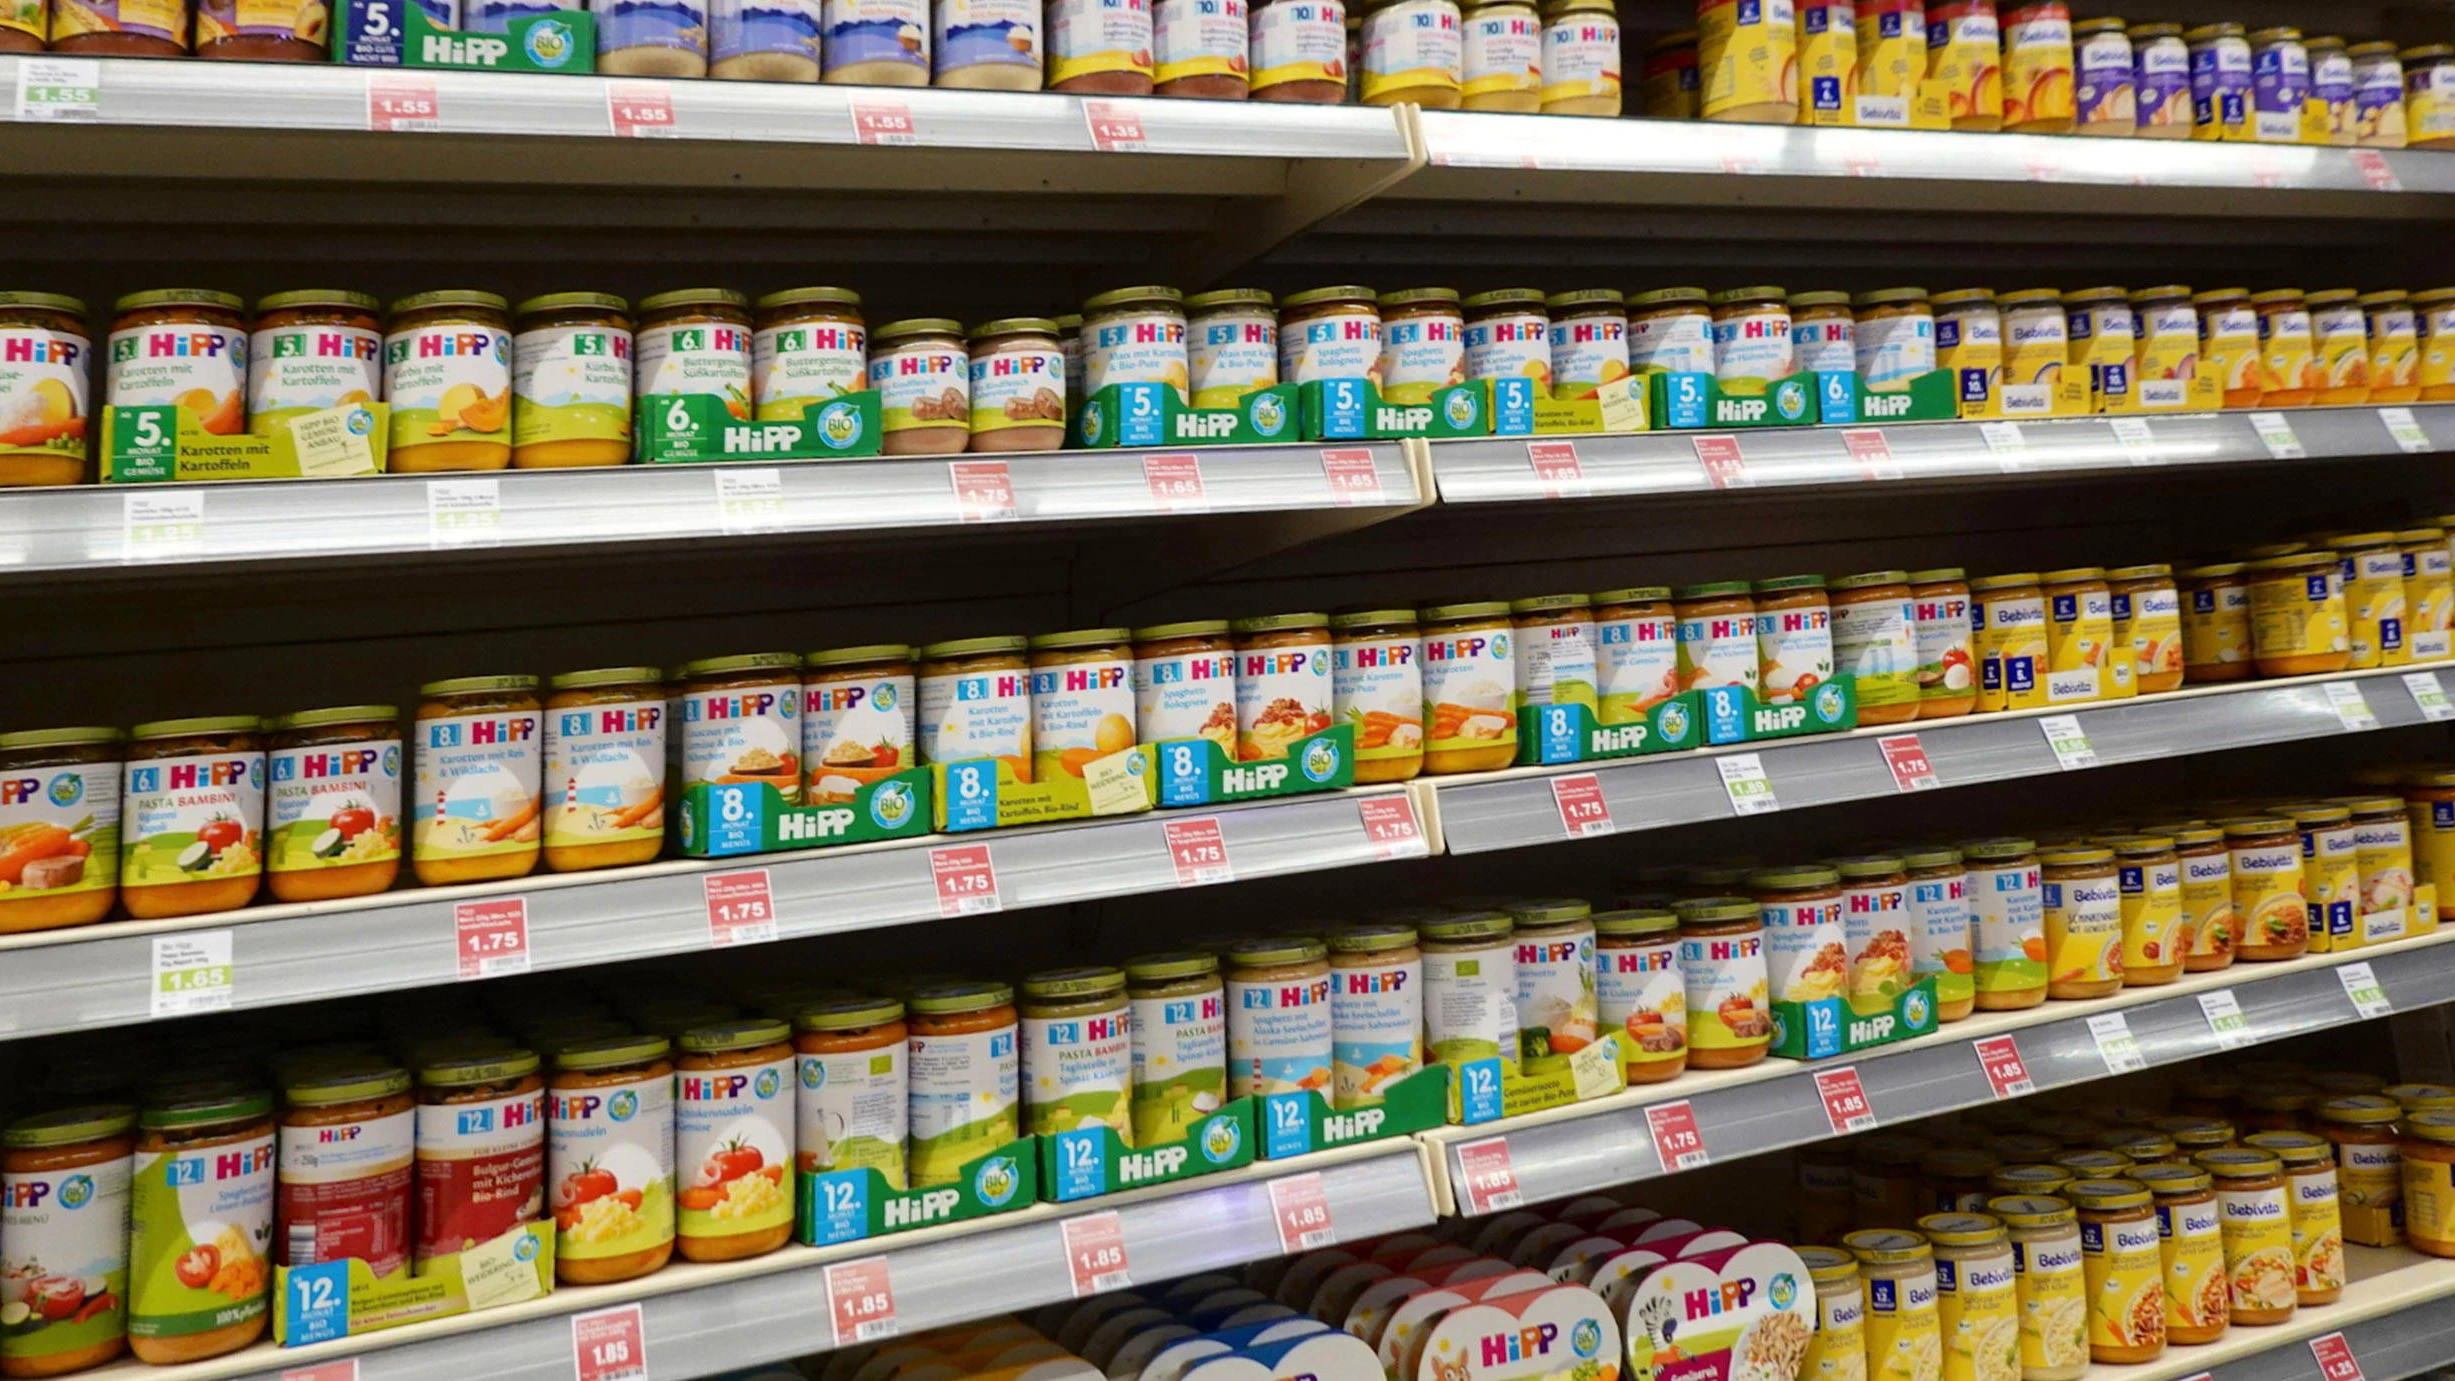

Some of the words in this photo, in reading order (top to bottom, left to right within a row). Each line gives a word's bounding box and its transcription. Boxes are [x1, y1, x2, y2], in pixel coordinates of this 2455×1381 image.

[364, 3, 400, 36] 5.
[422, 35, 509, 65] HiPP
[535, 36, 562, 51] BIO
[34, 89, 91, 102] 1.55
[380, 101, 430, 114] 1.55
[622, 107, 668, 121] 1.55
[865, 115, 907, 130] 1.55
[1099, 124, 1138, 138] 1.35
[816, 327, 865, 352] HiPP
[1136, 323, 1185, 344] HiPP
[1496, 322, 1545, 342] HiPP
[1574, 319, 1622, 343] HiPP
[1746, 321, 1789, 340] HiPP
[5, 338, 78, 366] HiPP
[149, 333, 226, 358] HiPP
[318, 333, 379, 361] HiPP
[419, 334, 490, 359] HiPP
[901, 356, 953, 375] HiPP
[994, 356, 1045, 376] HiPP
[1336, 381, 1362, 410] 5.
[1506, 382, 1530, 409] 5.
[1679, 377, 1703, 402] 5.
[1828, 374, 1850, 401] 6.
[1133, 387, 1160, 416] 5.
[1716, 399, 1768, 422] HiPP
[1864, 395, 1913, 417] HiPP
[666, 399, 700, 431] 6.
[828, 417, 852, 431] BIO
[1176, 412, 1240, 438] HiPP
[1376, 406, 1434, 432] HiPP
[134, 411, 173, 448] 5.
[724, 425, 803, 453] HiPP
[126, 447, 163, 458] MONAT
[180, 446, 244, 460] Karotten
[247, 444, 271, 457] mit
[663, 449, 699, 459] GEMÜSE
[673, 440, 690, 450] BIO
[124, 465, 167, 478] GEMÜSE
[135, 456, 157, 468] BIO
[180, 459, 252, 474] Kartoffeln
[1784, 610, 1828, 632] HiPP
[1917, 600, 1965, 621] HiPP
[1551, 626, 1579, 639] HiPP
[1358, 645, 1412, 667] HiPP
[1428, 638, 1486, 661] HiPP
[1161, 664, 1178, 682] 8.
[1247, 652, 1307, 677] HiPP
[1435, 664, 1474, 675] Karotten
[966, 680, 986, 699] 8.
[1066, 667, 1125, 692] HiPP
[2053, 682, 2092, 696] Bebivita
[806, 686, 866, 712] HiPP
[1163, 687, 1207, 701] Spaghetti
[1163, 697, 1209, 711] Bolognese
[1715, 690, 1738, 717] 8.
[708, 692, 775, 720] HiPP
[968, 703, 1009, 717] Karotten
[569, 714, 587, 735] 8.
[602, 707, 661, 734] HiPP
[1550, 709, 1574, 738] 8.
[1754, 705, 1807, 732] HiPP
[439, 725, 456, 747] 8.
[471, 718, 536, 746] HiPP
[1592, 725, 1648, 753] HiPP
[570, 741, 615, 754] Karotten
[617, 739, 634, 749] mit
[303, 749, 378, 779] HiPP
[440, 752, 484, 767] Karotten
[486, 751, 506, 762] mit
[581, 752, 630, 765] Wildlachs
[1173, 746, 1202, 776] 8.
[1310, 752, 1332, 766] BIO
[1896, 760, 1928, 776] 1.75
[170, 760, 246, 790] HiPP
[450, 763, 501, 778] Wildlachs
[1223, 763, 1289, 795] HiPP
[277, 785, 308, 798] PASTA
[310, 780, 367, 796] BAMBINI
[960, 767, 991, 798] 8.
[1180, 785, 1193, 794] BIO
[138, 796, 174, 809] PASTA
[177, 792, 237, 808] BAMBINI
[721, 786, 755, 822] 8.
[880, 797, 905, 811] BIO
[999, 797, 1039, 808] Karotten
[1039, 794, 1053, 804] mit
[999, 806, 1043, 819] Kartoffeln,
[1044, 802, 1080, 814] Bio-Rind
[1568, 801, 1603, 818] 1.75
[966, 807, 981, 817] BIO
[728, 831, 744, 840] BIO
[778, 809, 857, 840] HiPP
[1376, 823, 1413, 839] 1.75
[1181, 847, 1221, 864] 1.75
[2241, 854, 2294, 870] Bebivita
[945, 874, 989, 893] 1.75
[718, 902, 766, 921] 1.75
[1851, 891, 1902, 913] HiPP
[1797, 903, 1842, 927] HiPP
[468, 932, 519, 953] 1.75
[1518, 941, 1576, 964] HiPP
[1710, 937, 1760, 960] HiPP
[1618, 950, 1673, 973] HiPP
[169, 966, 224, 990] 1.65
[1349, 970, 1408, 994] HiPP
[1280, 980, 1328, 1009] HiPP
[1294, 1012, 1308, 1021] mit
[1812, 1006, 1836, 1032] 12.
[1176, 1027, 1206, 1039] PASTA
[1850, 1015, 1895, 1045] HiPP
[1058, 1049, 1092, 1061] PASTA
[1469, 1067, 1498, 1095] 12.
[1992, 1062, 2022, 1079] 1.85
[684, 1074, 748, 1101] HiPP
[550, 1096, 601, 1121] HiPP
[1274, 1098, 1305, 1128] 12.
[1832, 1097, 1864, 1114] 1.85
[319, 1126, 362, 1143] HiPP
[1323, 1108, 1386, 1143] HiPP
[1210, 1133, 1232, 1148] BIO
[1663, 1131, 1697, 1148] 1.75
[216, 1143, 274, 1180] HiPP
[1064, 1138, 1099, 1168] 12.
[1119, 1146, 1188, 1182] HiPP
[473, 1177, 492, 1190] mit
[985, 1174, 1010, 1190] BIO
[1075, 1175, 1089, 1184] BIO
[473, 1187, 521, 1204] Bio-Rind
[824, 1181, 862, 1214] 12.
[884, 1189, 960, 1228] HiPP
[1287, 1206, 1326, 1228] 1.85
[2227, 1200, 2280, 1217] Bebivita
[834, 1221, 851, 1230] BIO
[1080, 1248, 1121, 1270] 1.85
[297, 1277, 342, 1312] 12.
[843, 1294, 888, 1317] 1.85
[1684, 1277, 1756, 1321] HiPP
[309, 1320, 328, 1330] BIO
[591, 1340, 629, 1367] 1.85
[1480, 1322, 1558, 1368] HiPP
